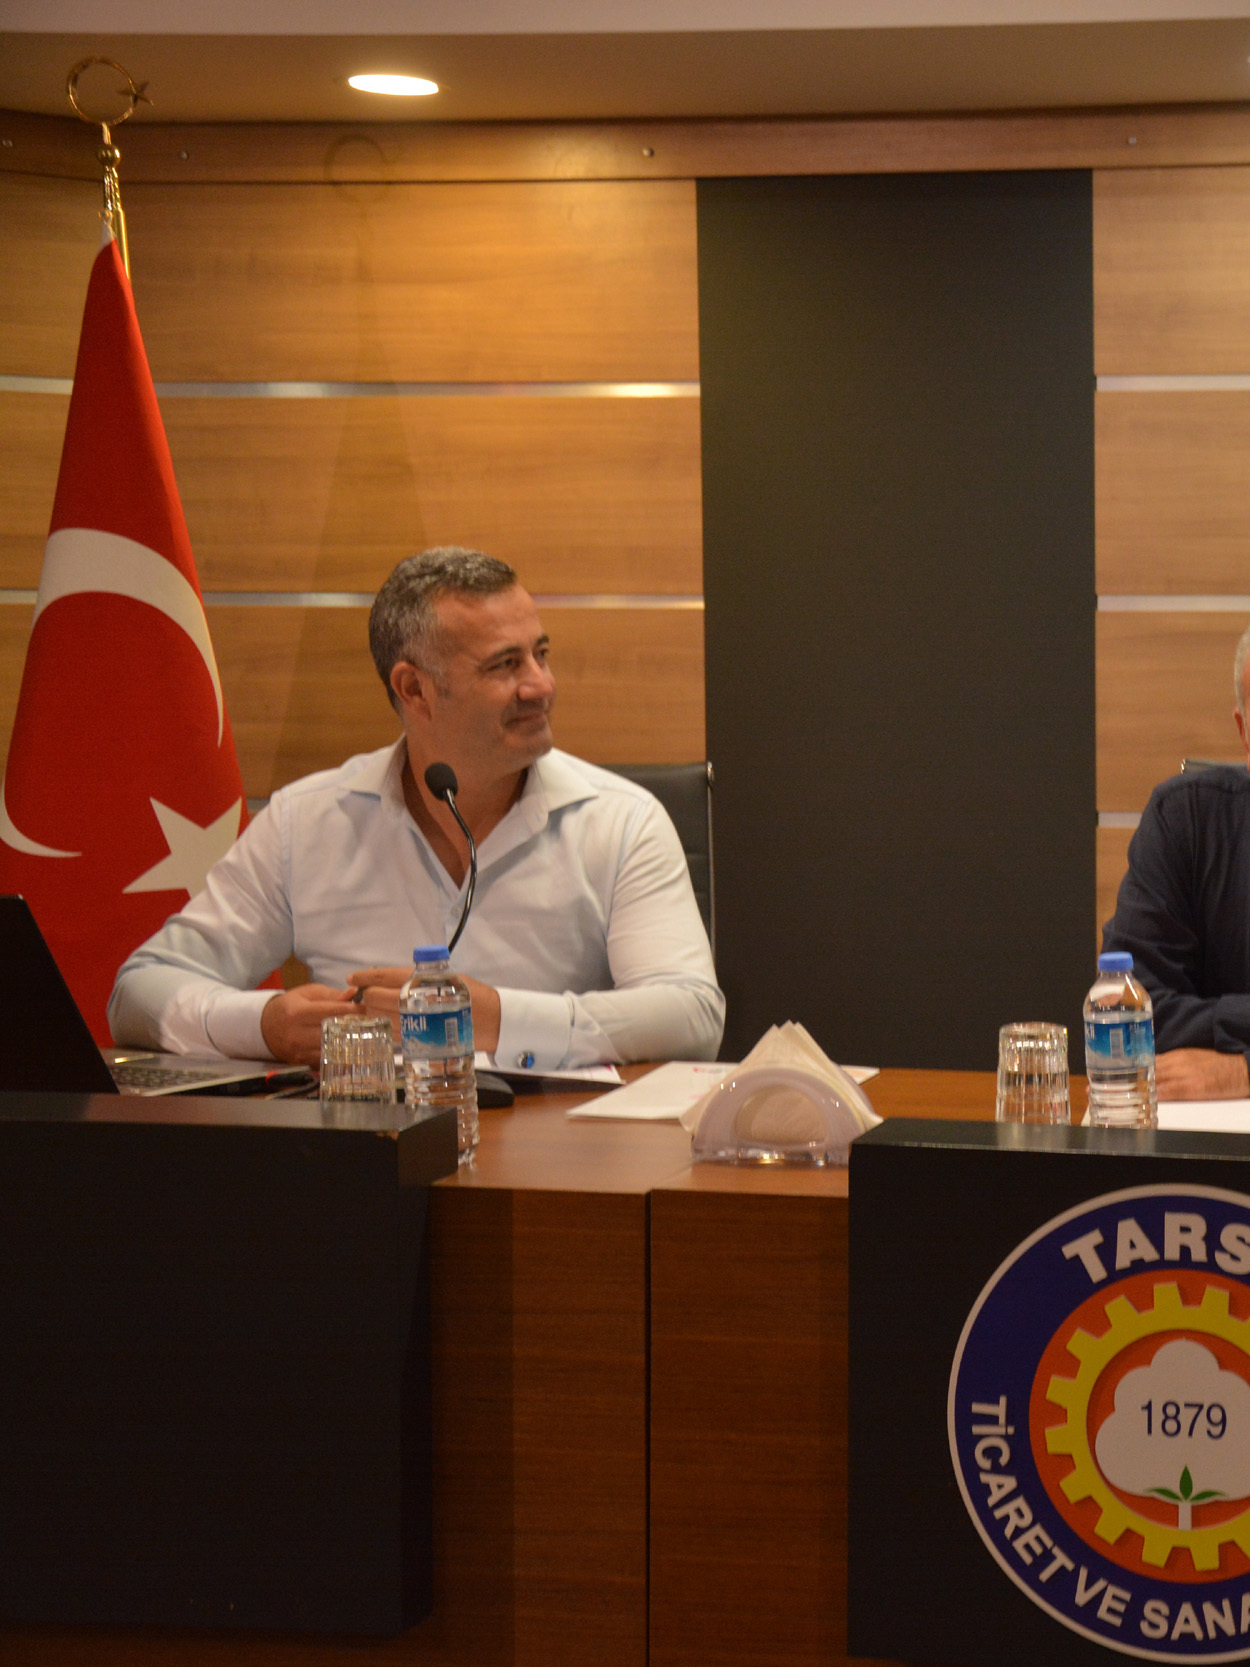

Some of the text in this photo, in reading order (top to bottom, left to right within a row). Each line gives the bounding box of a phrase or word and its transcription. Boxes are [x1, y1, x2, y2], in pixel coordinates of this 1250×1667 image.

[1140, 1399, 1228, 1439] 1879
[971, 1395, 1075, 1583] TİCARET
[1073, 1566, 1132, 1627] VE
